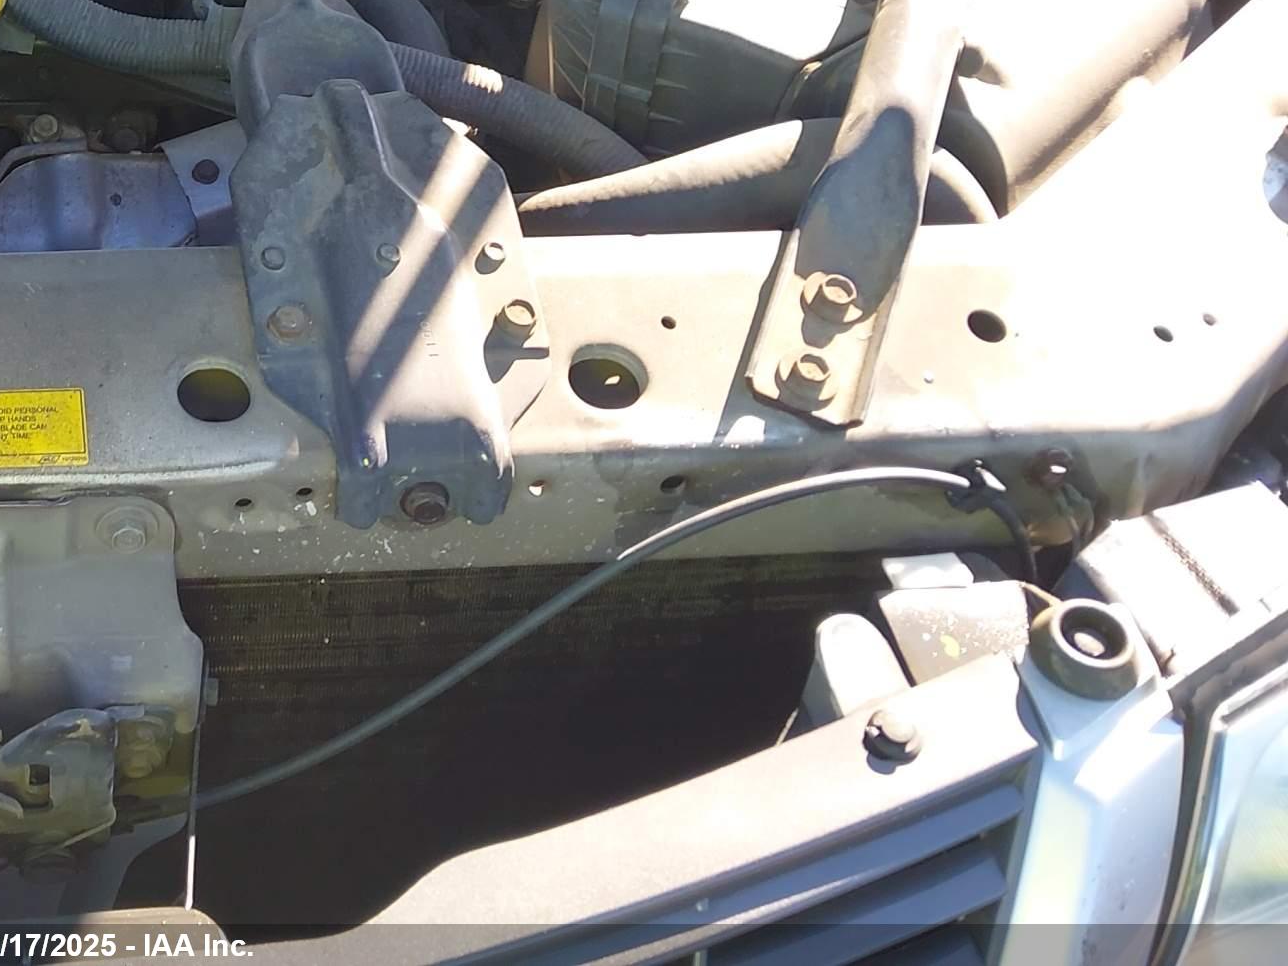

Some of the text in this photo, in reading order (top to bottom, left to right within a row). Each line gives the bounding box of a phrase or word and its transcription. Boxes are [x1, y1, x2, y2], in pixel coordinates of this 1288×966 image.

[14, 405, 58, 414] PERSONAL
[7, 415, 37, 423] HANDS
[0, 424, 27, 432] BLADE
